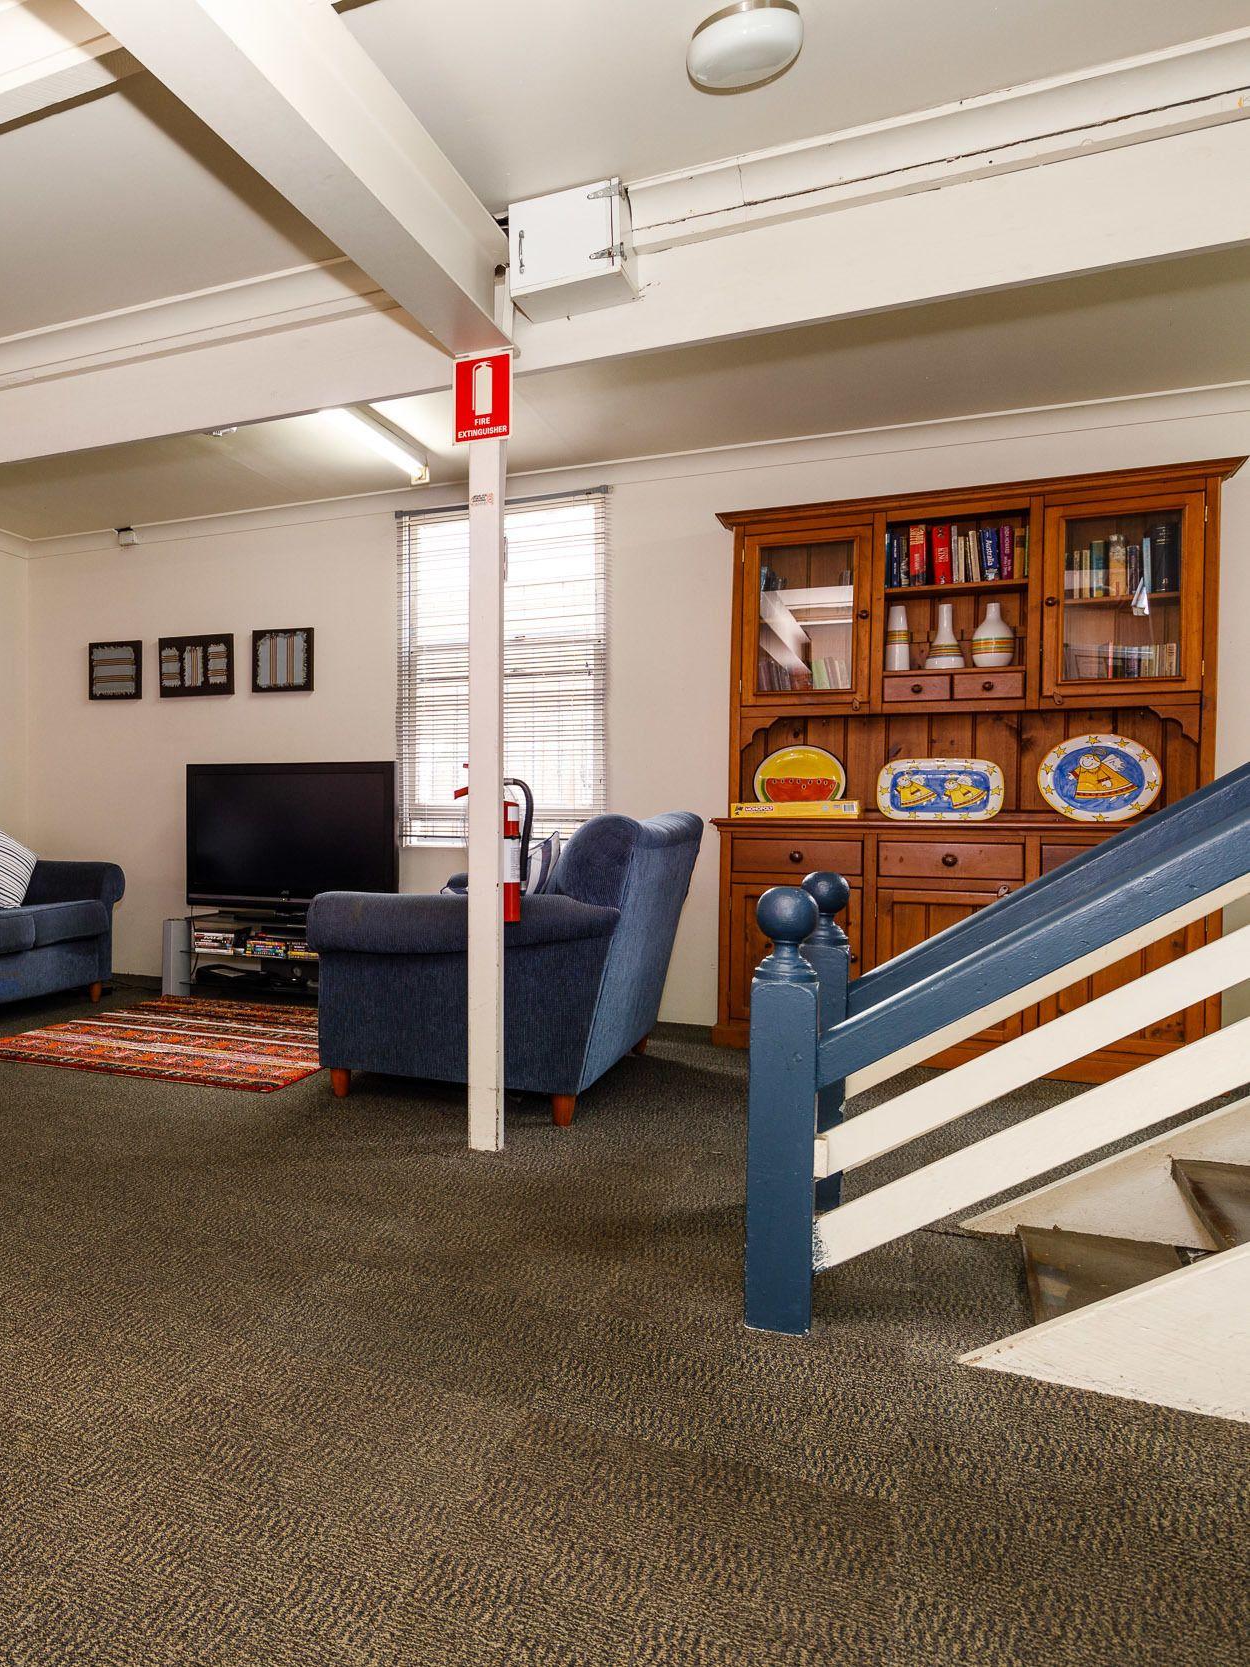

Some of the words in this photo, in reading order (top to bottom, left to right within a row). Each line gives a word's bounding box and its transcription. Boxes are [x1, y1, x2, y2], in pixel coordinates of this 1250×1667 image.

[474, 416, 491, 426] FIRE
[458, 425, 507, 438] EXTINGUISHER
[985, 539, 995, 566] Australia
